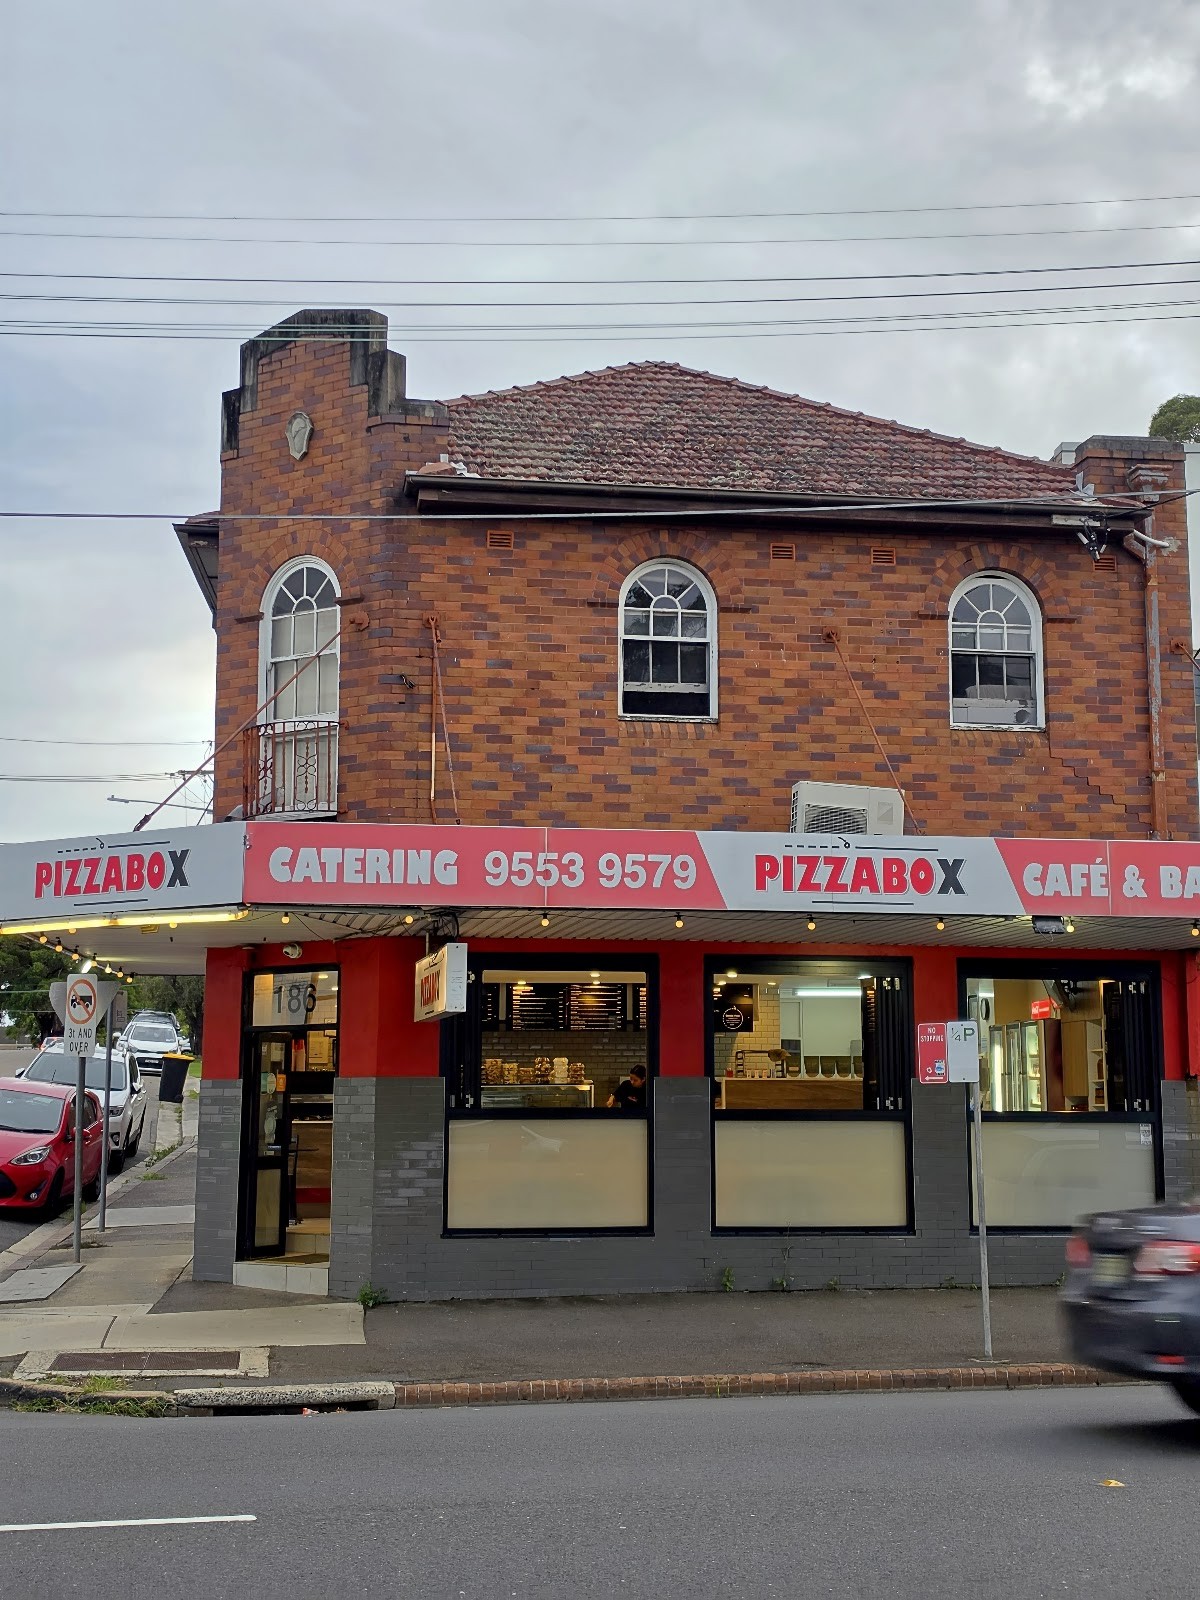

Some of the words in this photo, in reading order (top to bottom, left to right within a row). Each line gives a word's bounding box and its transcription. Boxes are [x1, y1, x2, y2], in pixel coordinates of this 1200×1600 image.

[34, 848, 191, 900] PIZZABOX
[268, 846, 459, 886] CATERING
[484, 850, 585, 887] 9553
[598, 852, 697, 890] 9579
[754, 854, 967, 896] PIZZABOX
[1022, 857, 1109, 897] CAFÉ
[1122, 864, 1148, 898] &
[273, 983, 317, 1014] 186
[69, 1041, 89, 1053] OVER
[77, 1028, 93, 1039] AND
[927, 1026, 936, 1034] NO
